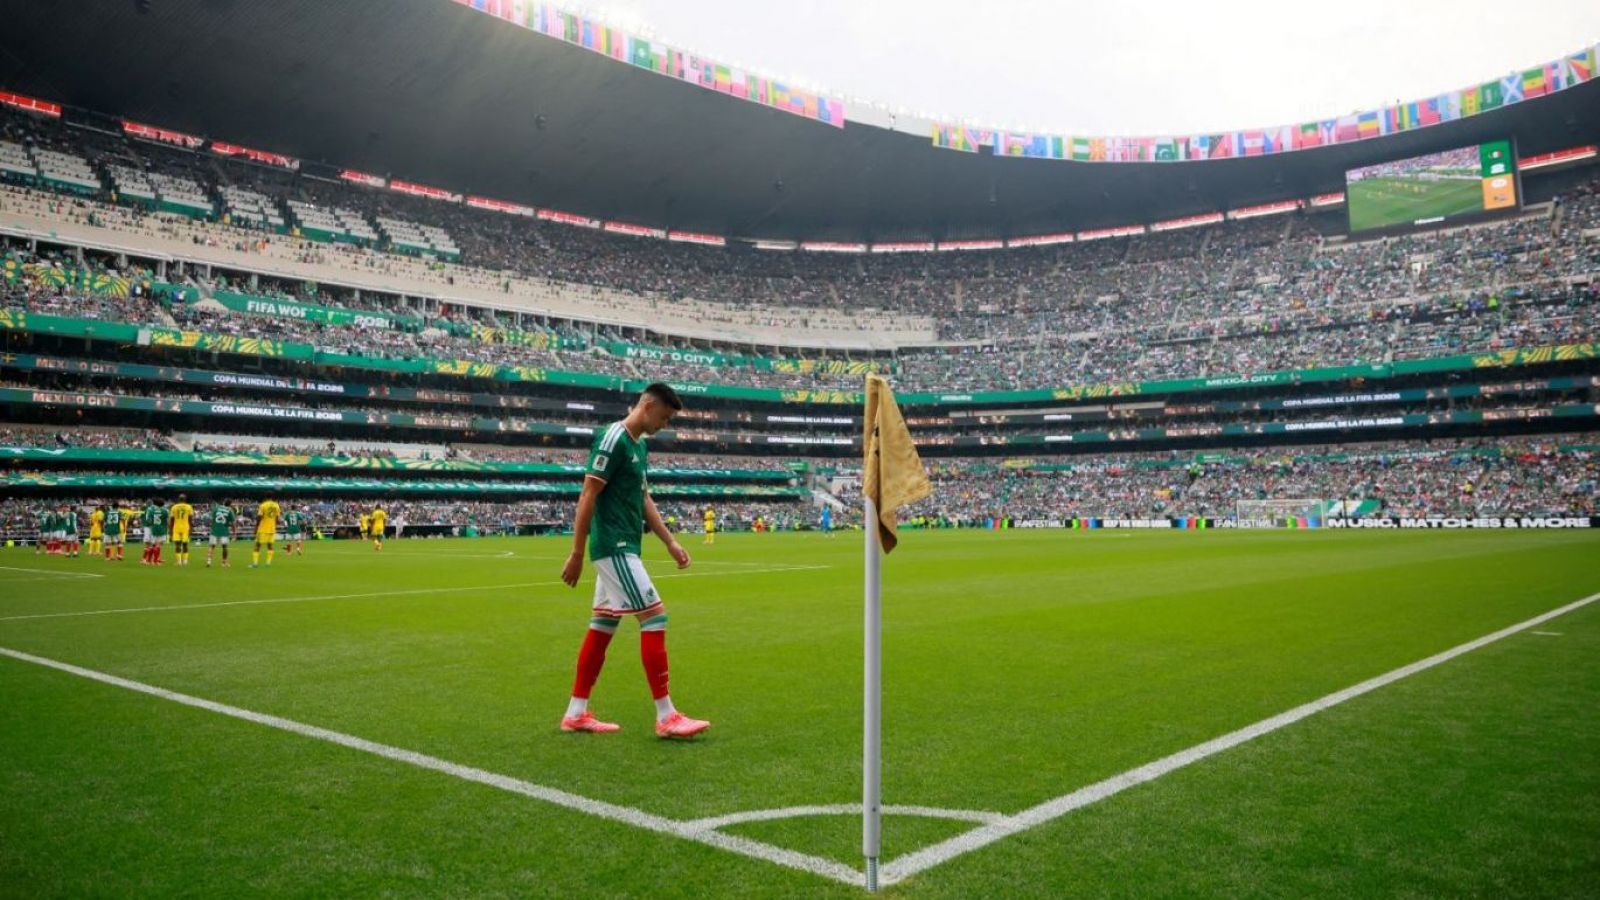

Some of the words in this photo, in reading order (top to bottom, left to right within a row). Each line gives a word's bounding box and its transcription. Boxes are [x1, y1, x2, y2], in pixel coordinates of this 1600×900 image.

[247, 301, 276, 315] FIFA
[683, 353, 714, 364] CITY
[213, 374, 237, 384] COPA
[238, 379, 274, 388] MUNDIAL
[1206, 377, 1249, 387] MEXICO
[1251, 374, 1277, 383] CITY
[88, 395, 117, 407] CITY
[1283, 399, 1302, 407] COPA
[211, 404, 234, 414] COPA
[235, 405, 272, 416] MUNDIAL
[274, 408, 285, 417] DE
[286, 409, 296, 417] LA
[297, 410, 314, 419] FIFA
[1285, 422, 1304, 430] COPA
[1348, 418, 1358, 426] LA
[215, 511, 227, 524] 25
[1328, 516, 1398, 530] MUSIC,
[1399, 517, 1502, 529] MATCHES
[1503, 517, 1519, 529] &
[1520, 517, 1591, 528] MORE
